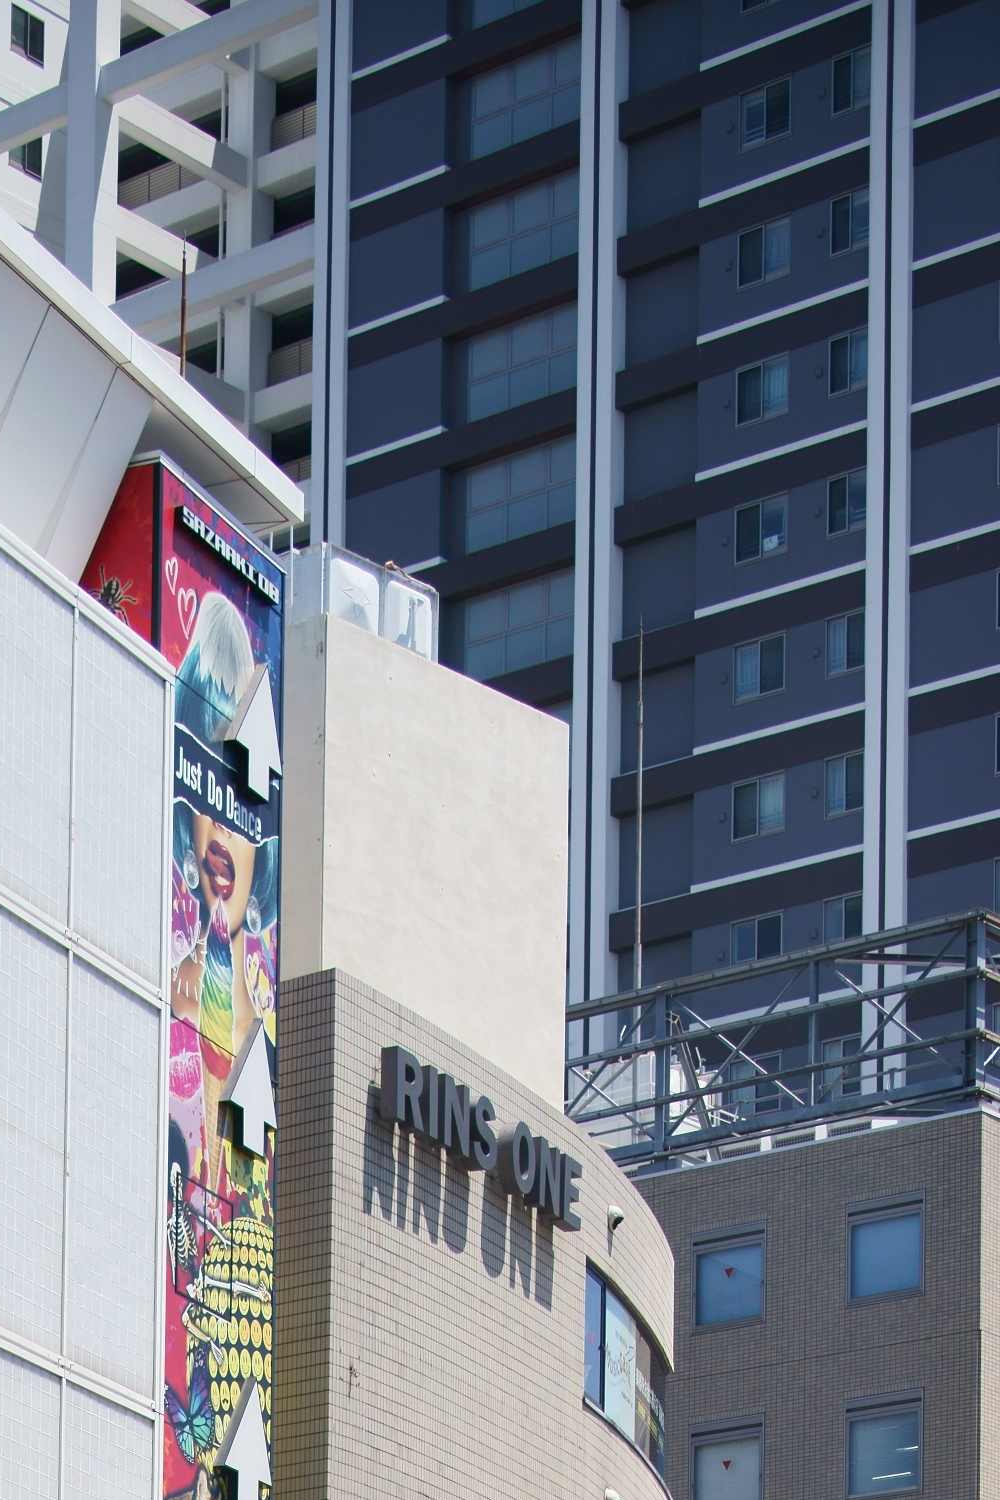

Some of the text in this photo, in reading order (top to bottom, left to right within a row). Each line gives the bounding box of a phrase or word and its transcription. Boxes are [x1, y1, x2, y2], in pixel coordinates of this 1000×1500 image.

[175, 745, 262, 841] Just Do Dance
[381, 1045, 582, 1232] RINS ONE
